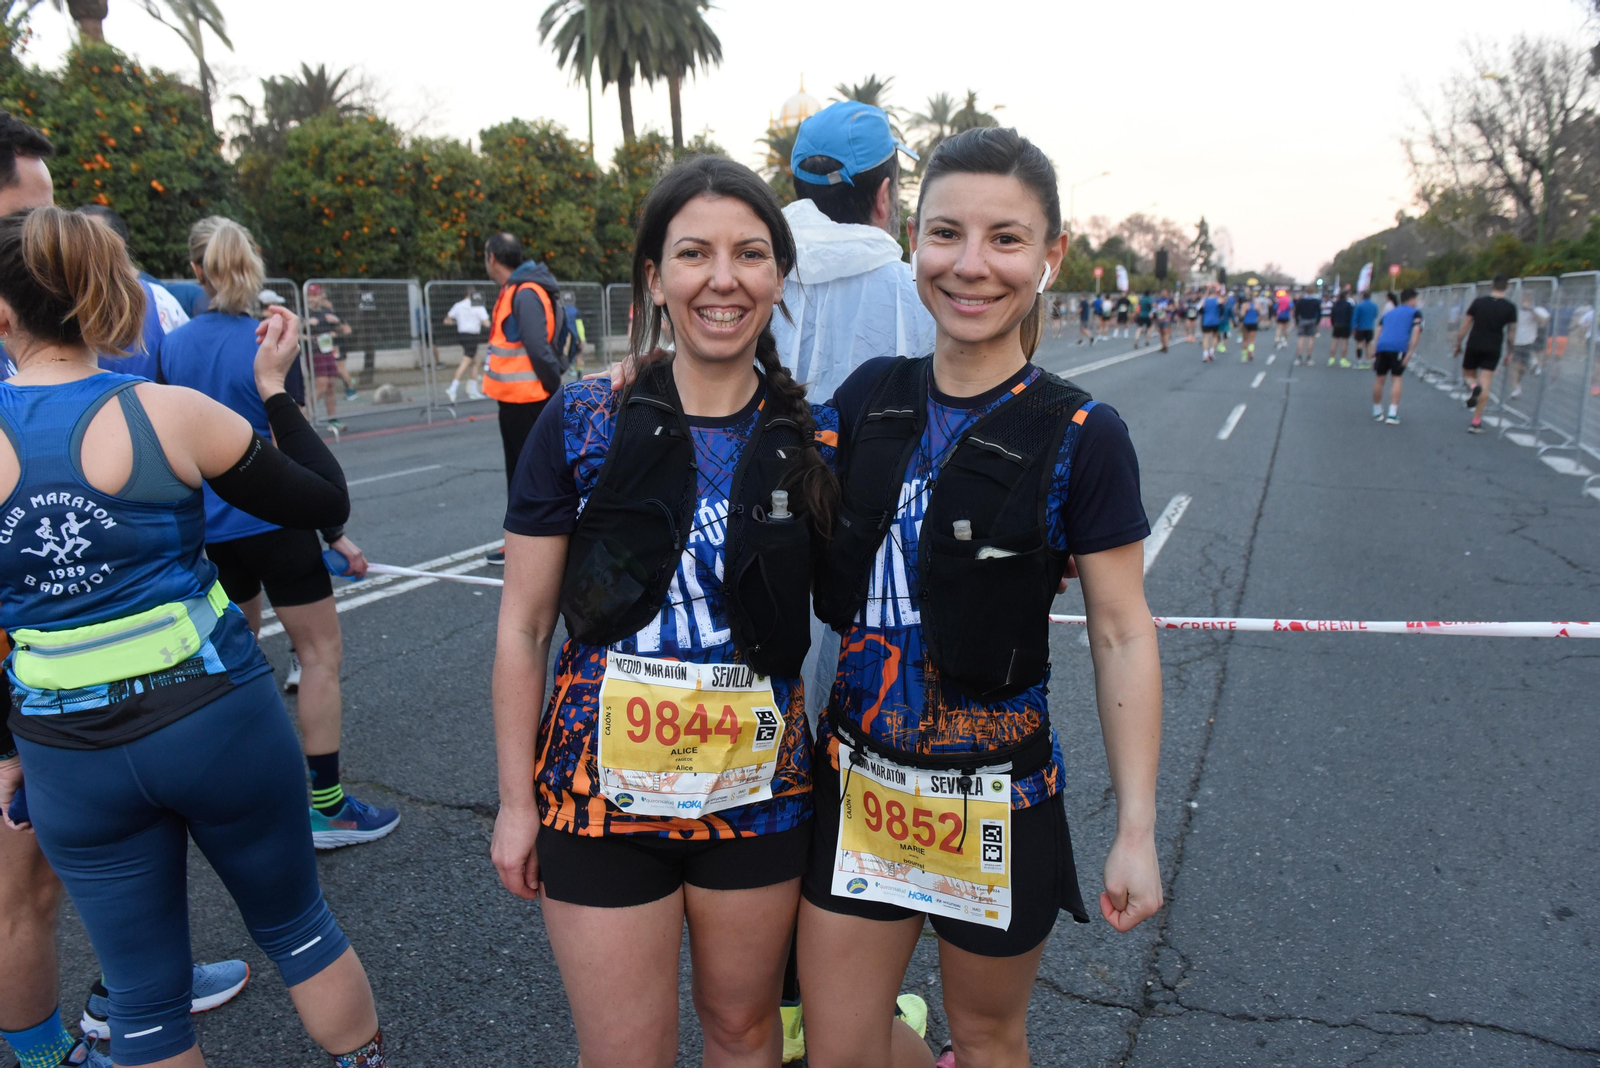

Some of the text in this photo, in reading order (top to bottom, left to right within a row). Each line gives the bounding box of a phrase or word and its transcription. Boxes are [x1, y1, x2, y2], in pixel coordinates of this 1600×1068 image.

[0, 492, 118, 544] CLUB MARATON
[24, 563, 115, 596] BADAJOZ
[48, 565, 86, 581] 1989
[615, 657, 755, 688] MEDIO MARATÓN SEVILLA
[604, 711, 612, 736] CAJÓN
[626, 696, 743, 746] 9844
[670, 746, 698, 756] ALICE
[676, 764, 694, 772] Alice
[870, 761, 906, 786] MARATÓN
[677, 800, 702, 810] HOKA
[863, 790, 964, 856] 9852
[899, 843, 926, 855] MARIE
[908, 890, 933, 904] HOKA
